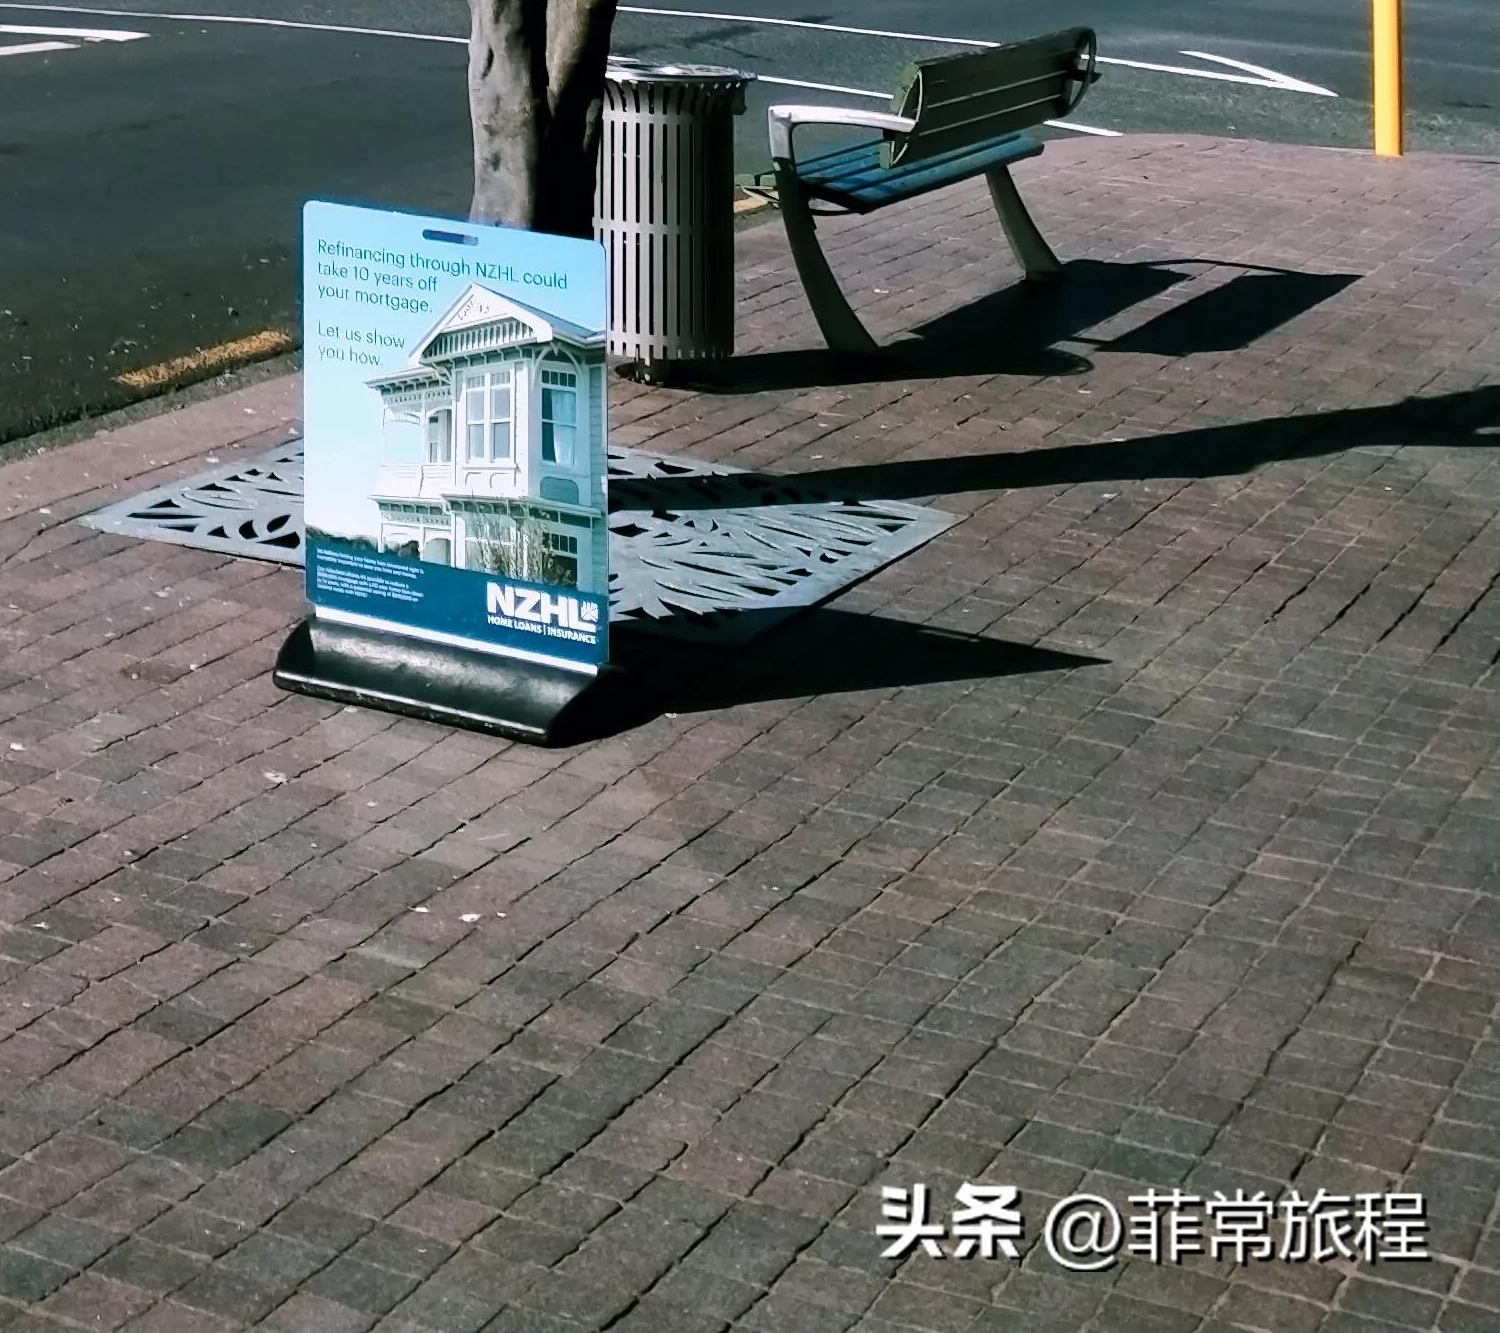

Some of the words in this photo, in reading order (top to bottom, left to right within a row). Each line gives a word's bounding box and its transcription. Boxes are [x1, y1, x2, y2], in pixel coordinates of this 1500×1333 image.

[317, 262, 348, 278] take
[353, 265, 369, 281] 10
[374, 271, 414, 290] years
[418, 275, 438, 292] off
[318, 239, 405, 269] Refinancing
[410, 252, 471, 278] through
[476, 262, 519, 283] NZHL
[523, 271, 569, 290] could
[318, 284, 350, 300] your
[355, 289, 433, 313] mortgage.
[318, 321, 341, 339] Let
[345, 328, 362, 342] us
[366, 327, 405, 350] show
[317, 344, 345, 361] you
[486, 580, 597, 633] NZHL
[487, 614, 513, 629] HOME
[514, 618, 543, 635] LOANS
[547, 626, 597, 645] INSURANCE
